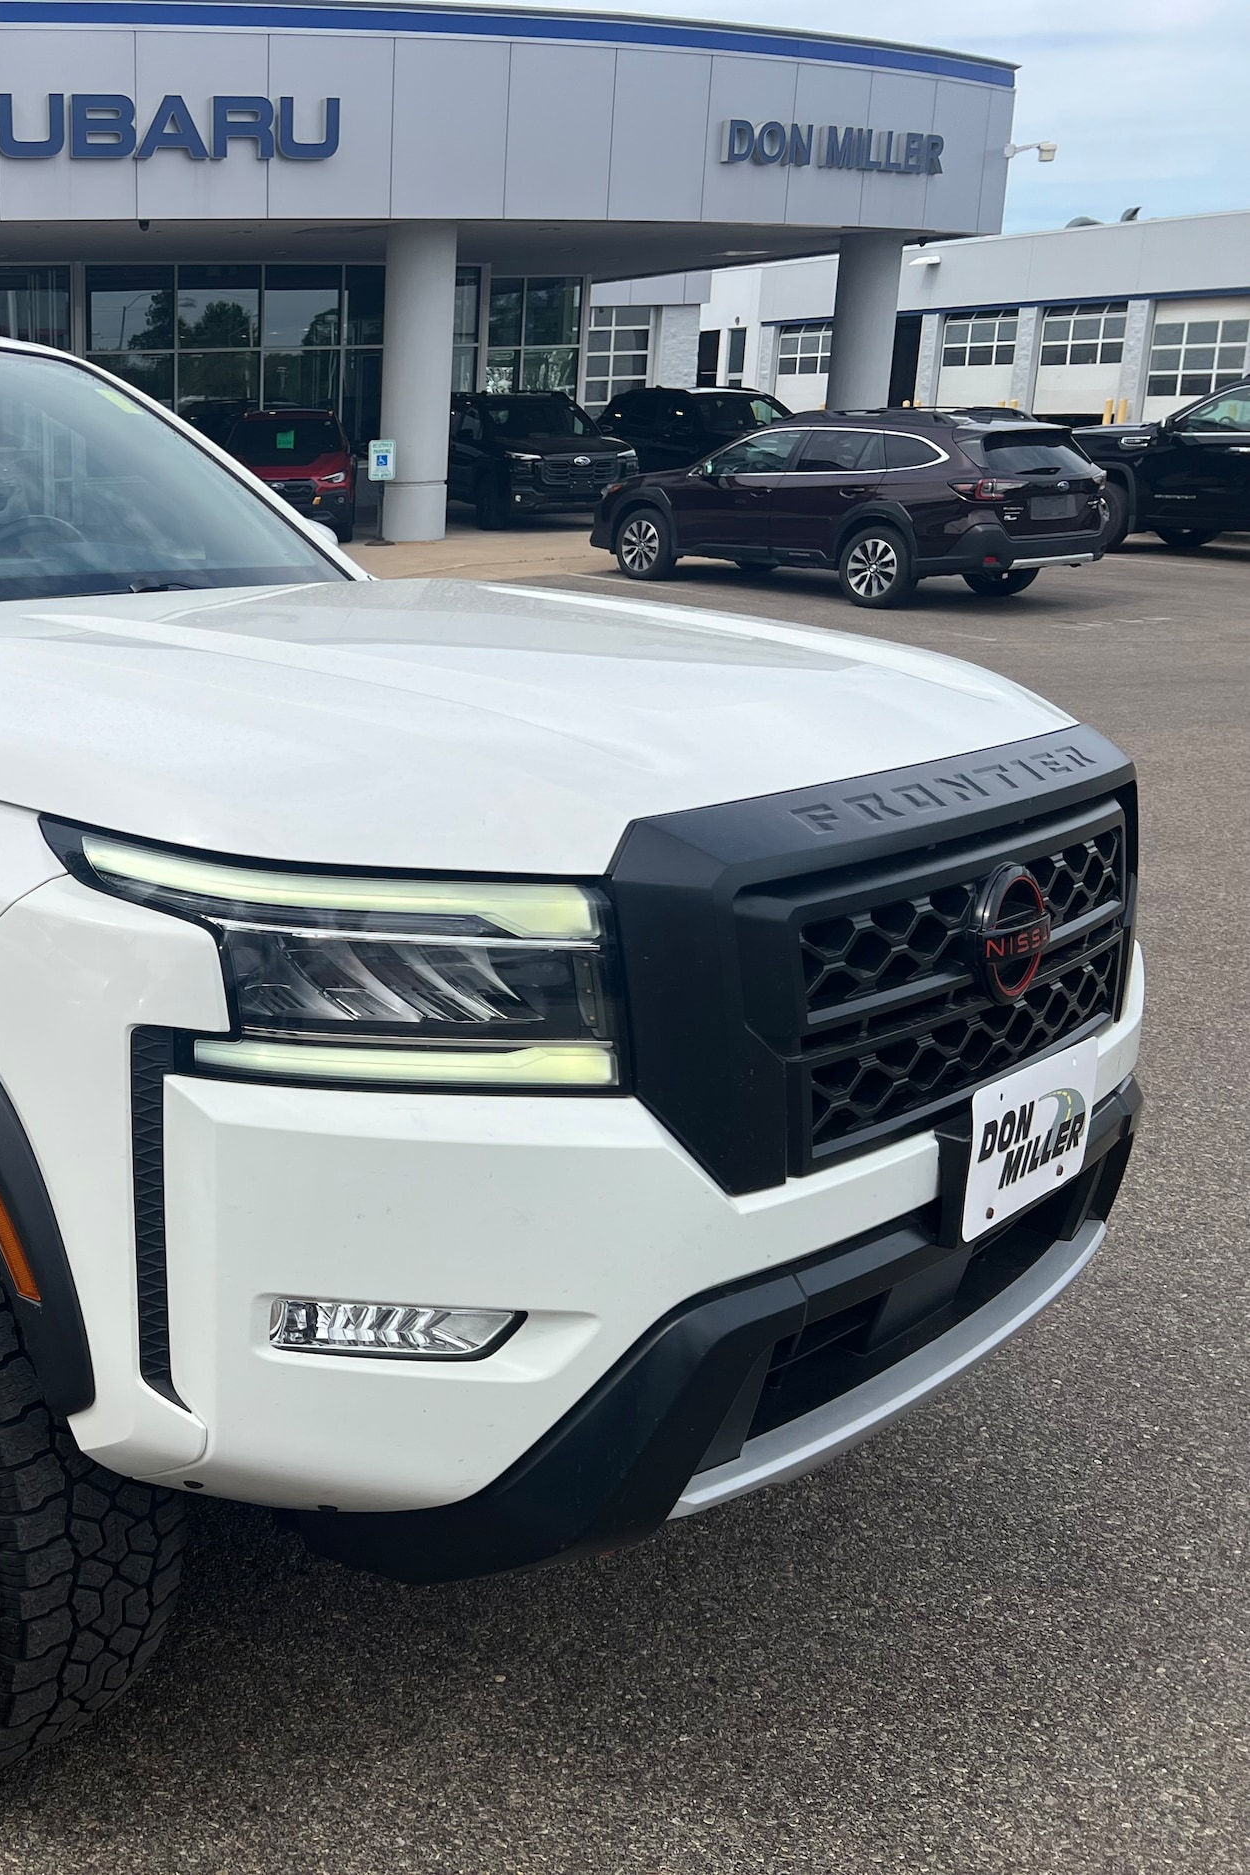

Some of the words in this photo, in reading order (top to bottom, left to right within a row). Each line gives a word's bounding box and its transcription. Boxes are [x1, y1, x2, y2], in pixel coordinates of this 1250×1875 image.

[721, 119, 814, 166] DON
[818, 125, 945, 175] MILLER
[788, 745, 1098, 836] FRONTIER
[977, 1100, 1035, 1164] DON
[997, 1111, 1086, 1191] MILLER
